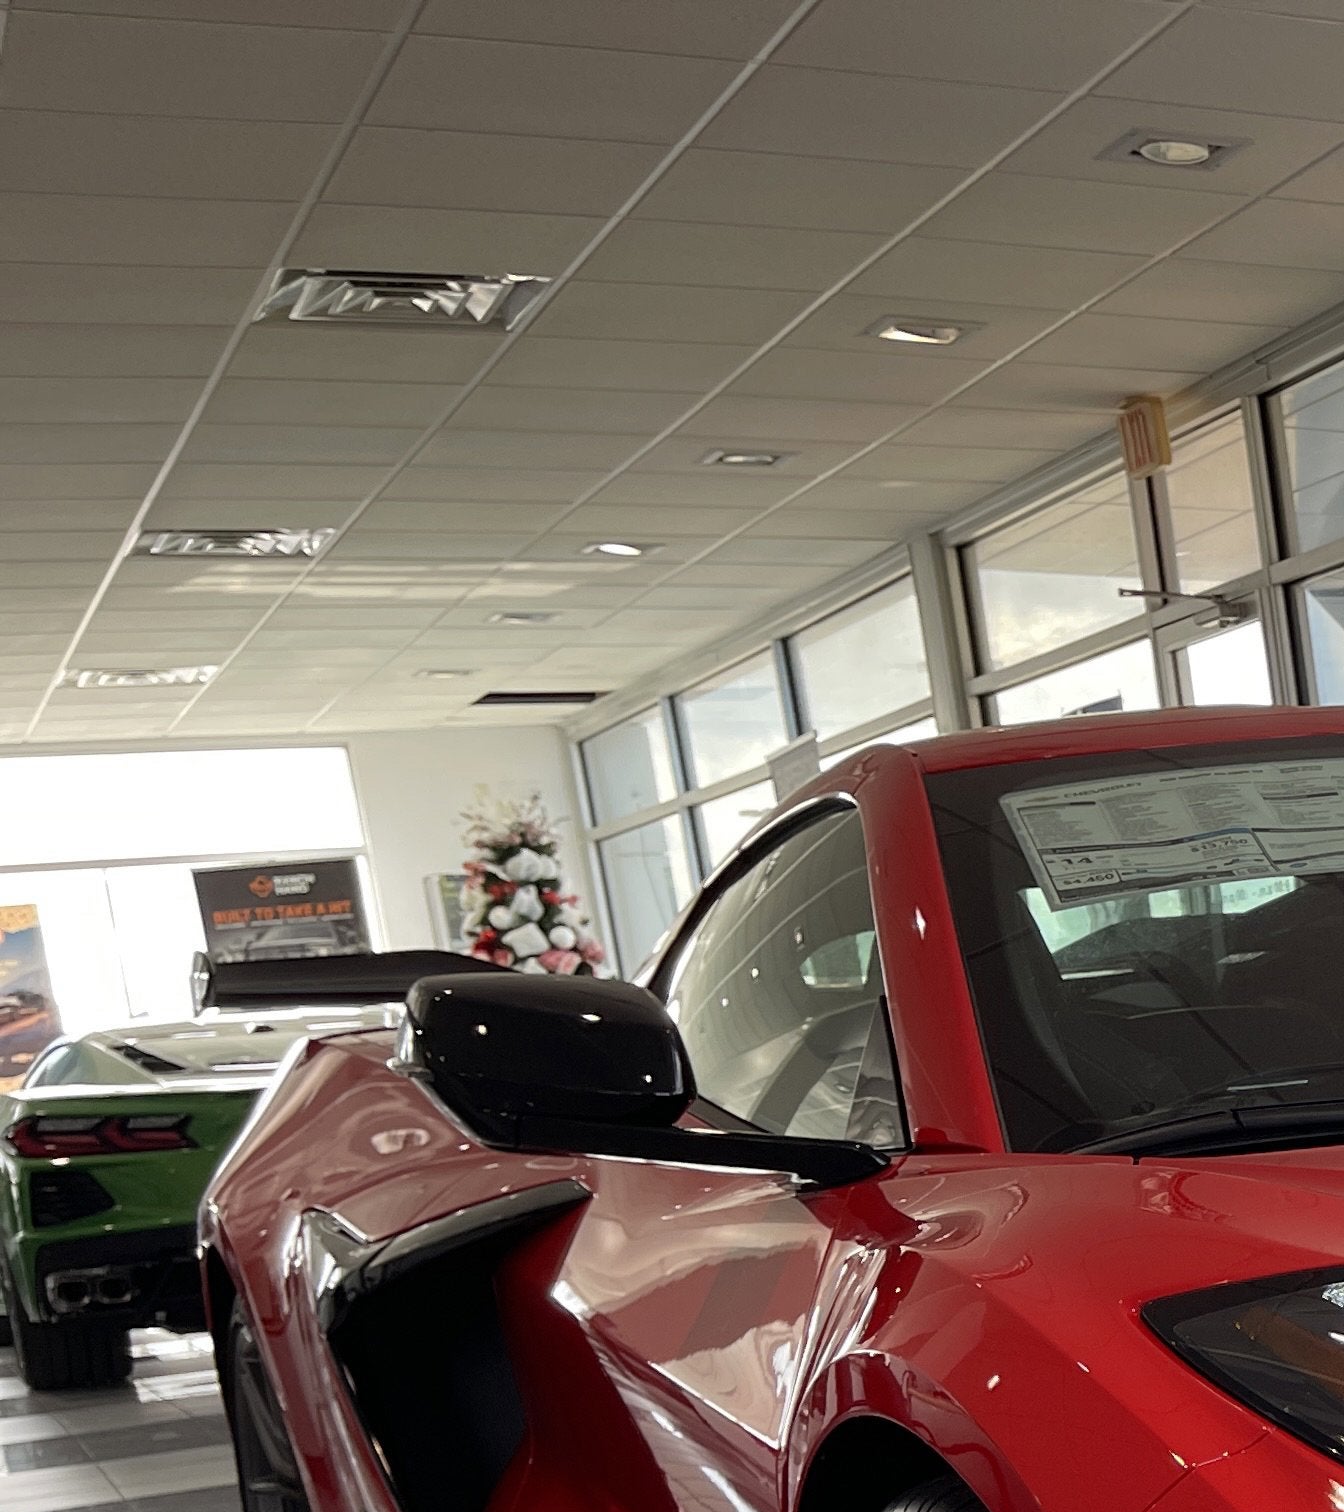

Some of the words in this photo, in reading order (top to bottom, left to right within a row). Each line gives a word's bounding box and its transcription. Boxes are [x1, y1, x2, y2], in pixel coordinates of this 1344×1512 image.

[1063, 782, 1143, 798] CHEVROLET
[254, 906, 274, 921] TO
[276, 902, 313, 919] TAKE
